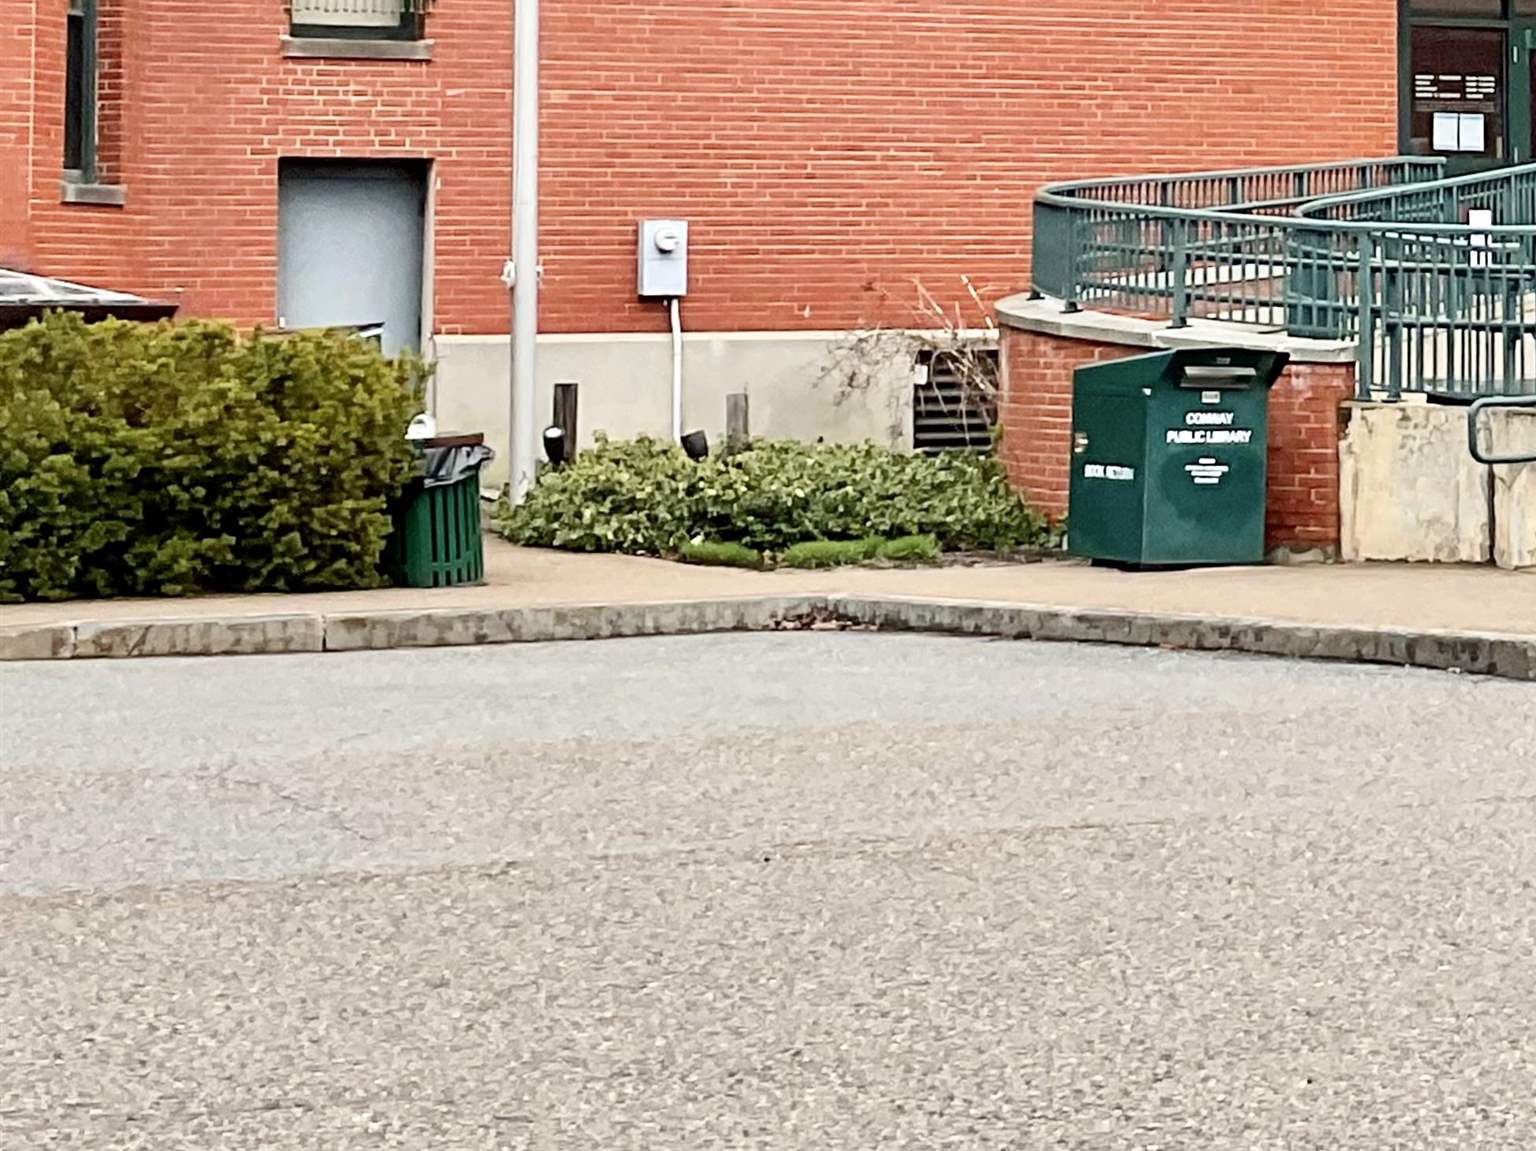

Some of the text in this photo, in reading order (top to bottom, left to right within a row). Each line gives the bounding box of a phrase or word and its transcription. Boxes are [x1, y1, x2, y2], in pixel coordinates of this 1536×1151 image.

[1185, 412, 1234, 425] CONWAY
[1166, 430, 1252, 443] PUBLIC LIBRARY
